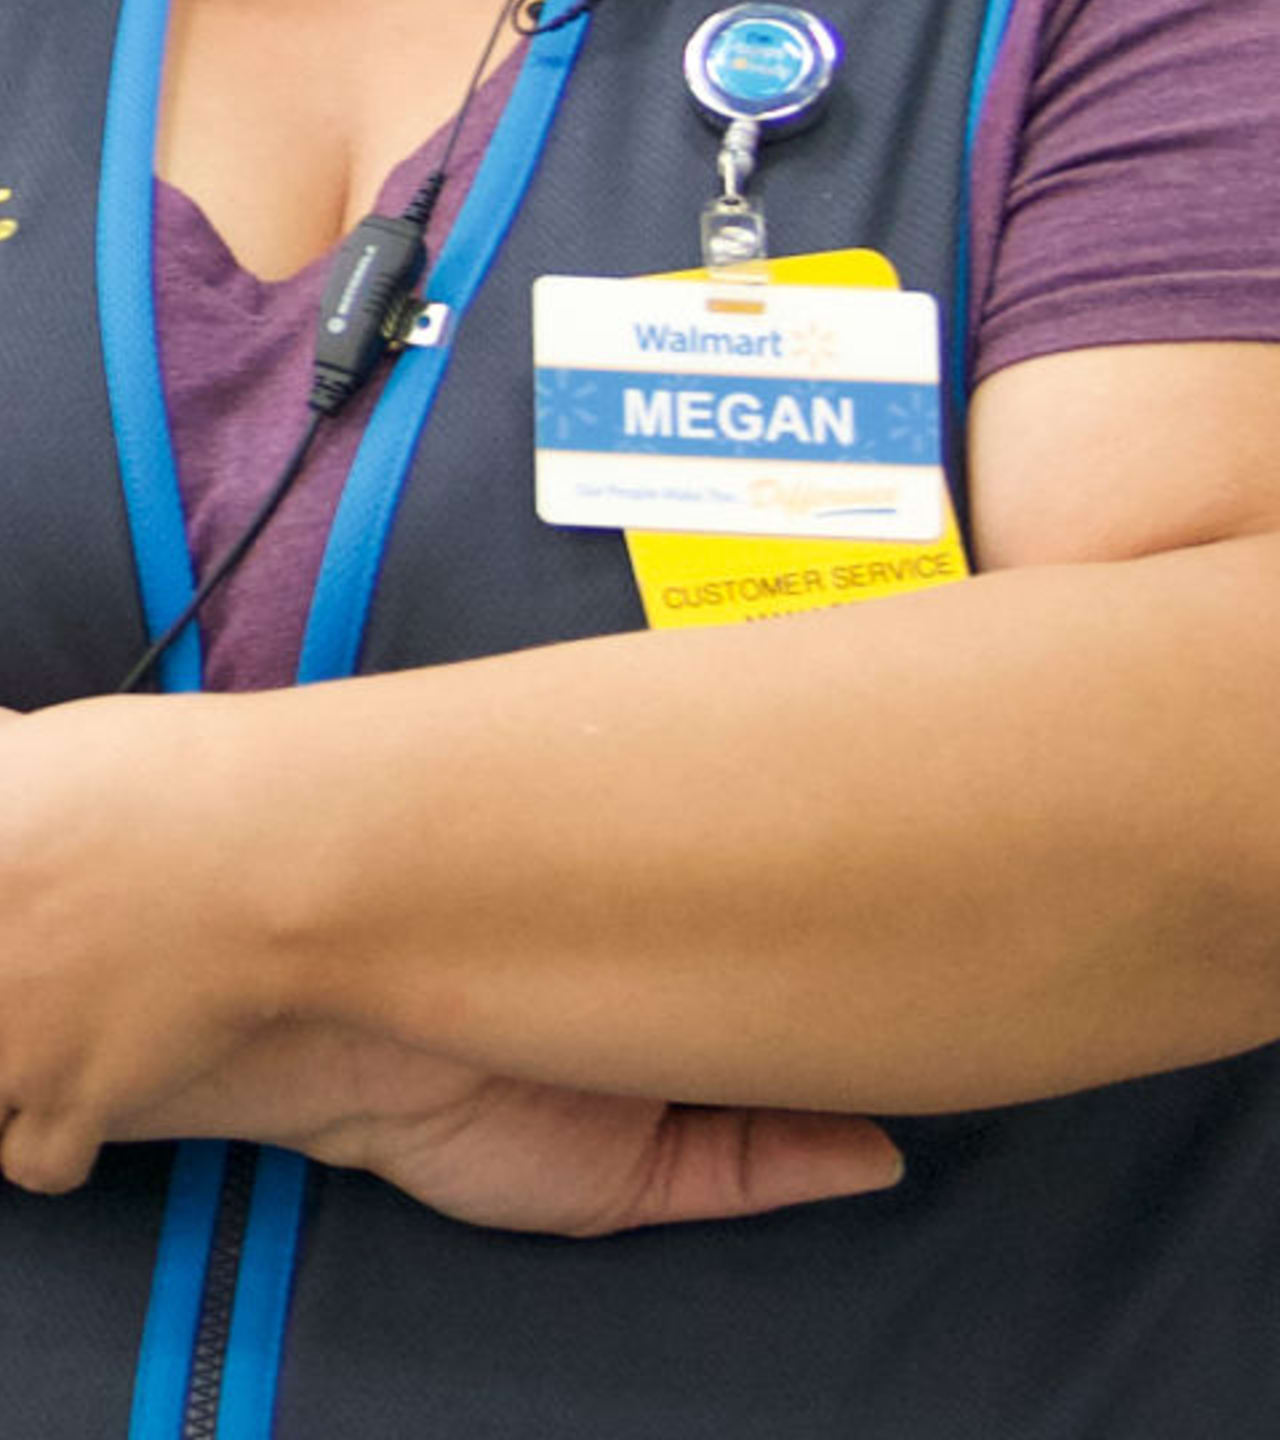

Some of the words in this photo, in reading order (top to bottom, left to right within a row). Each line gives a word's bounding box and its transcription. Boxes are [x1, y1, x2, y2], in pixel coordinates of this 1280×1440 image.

[634, 324, 783, 358] Walmart
[622, 388, 855, 446] MEGAN
[661, 569, 824, 610] CUSTOMER
[831, 552, 953, 591] SERVICE
